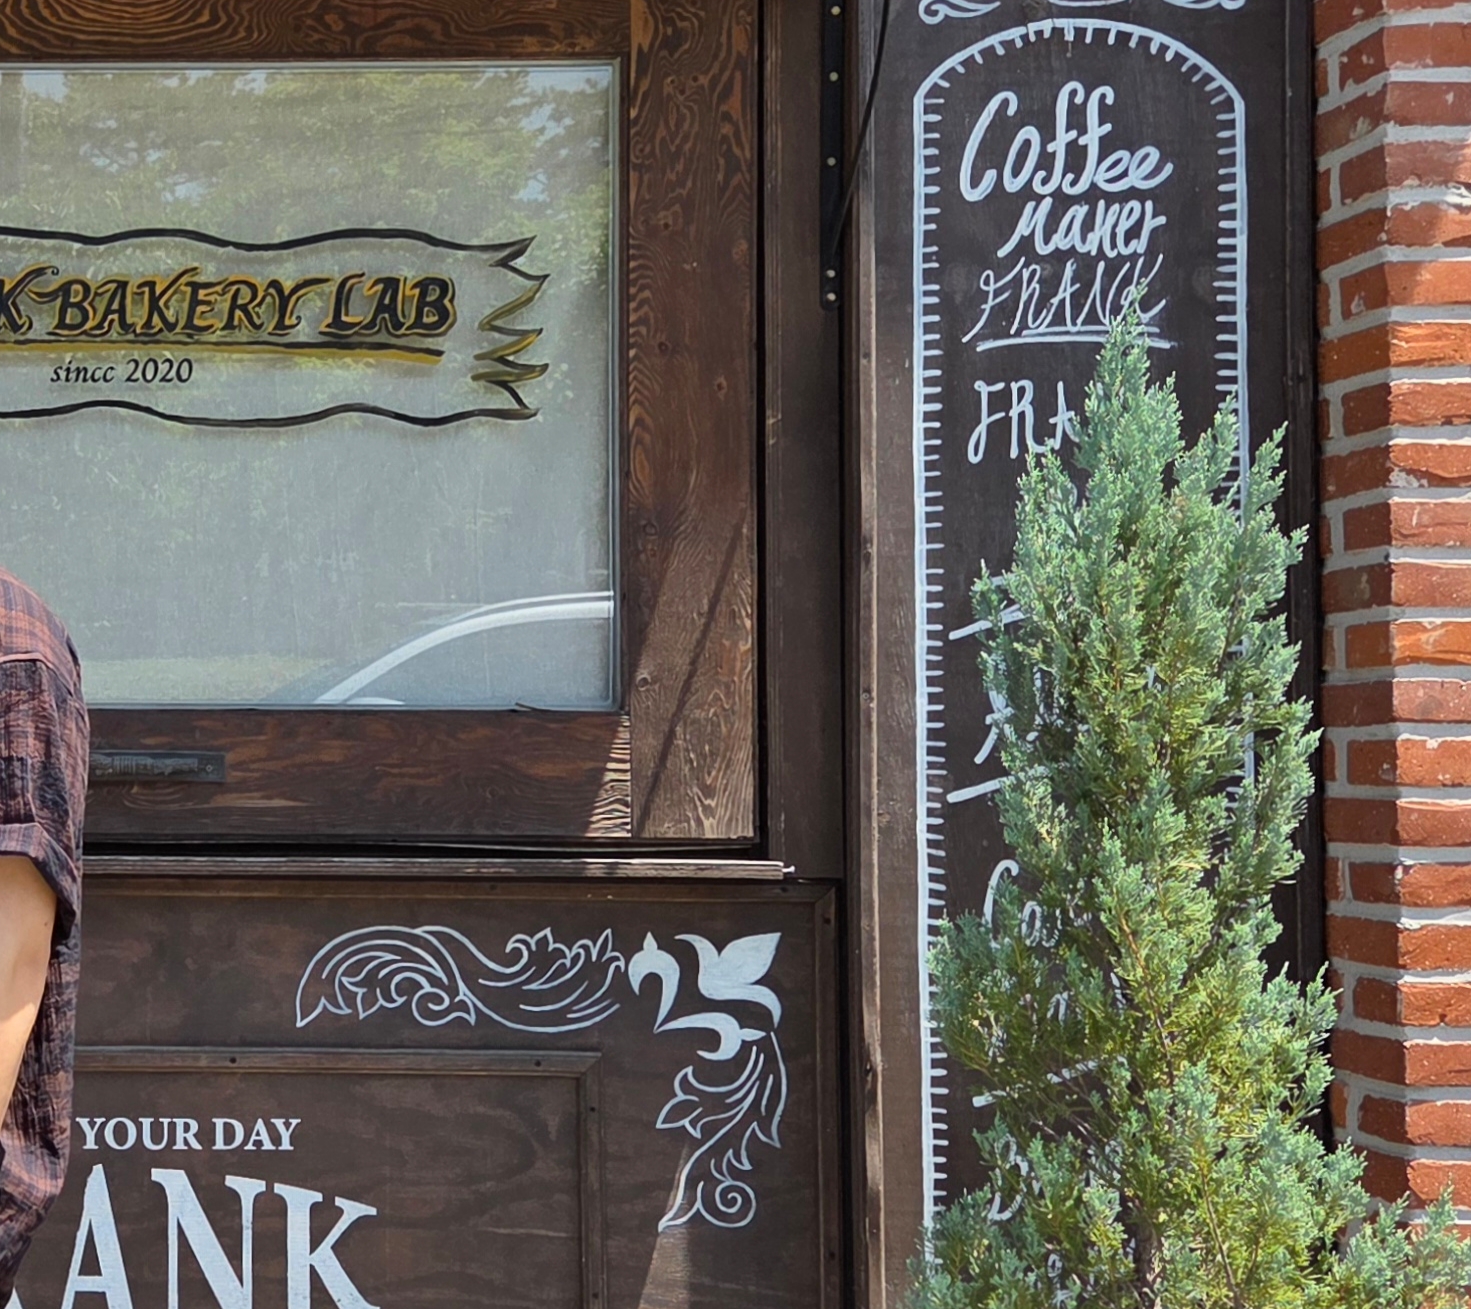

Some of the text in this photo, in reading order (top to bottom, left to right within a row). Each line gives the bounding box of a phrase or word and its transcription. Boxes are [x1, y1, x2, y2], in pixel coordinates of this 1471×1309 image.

[960, 81, 1173, 201] Coffee
[32, 266, 332, 337] BAKERY
[319, 271, 457, 338] LAB
[125, 357, 193, 383] 2020
[968, 379, 1080, 464] FRA
[76, 1117, 302, 1151] YOUR DAY
